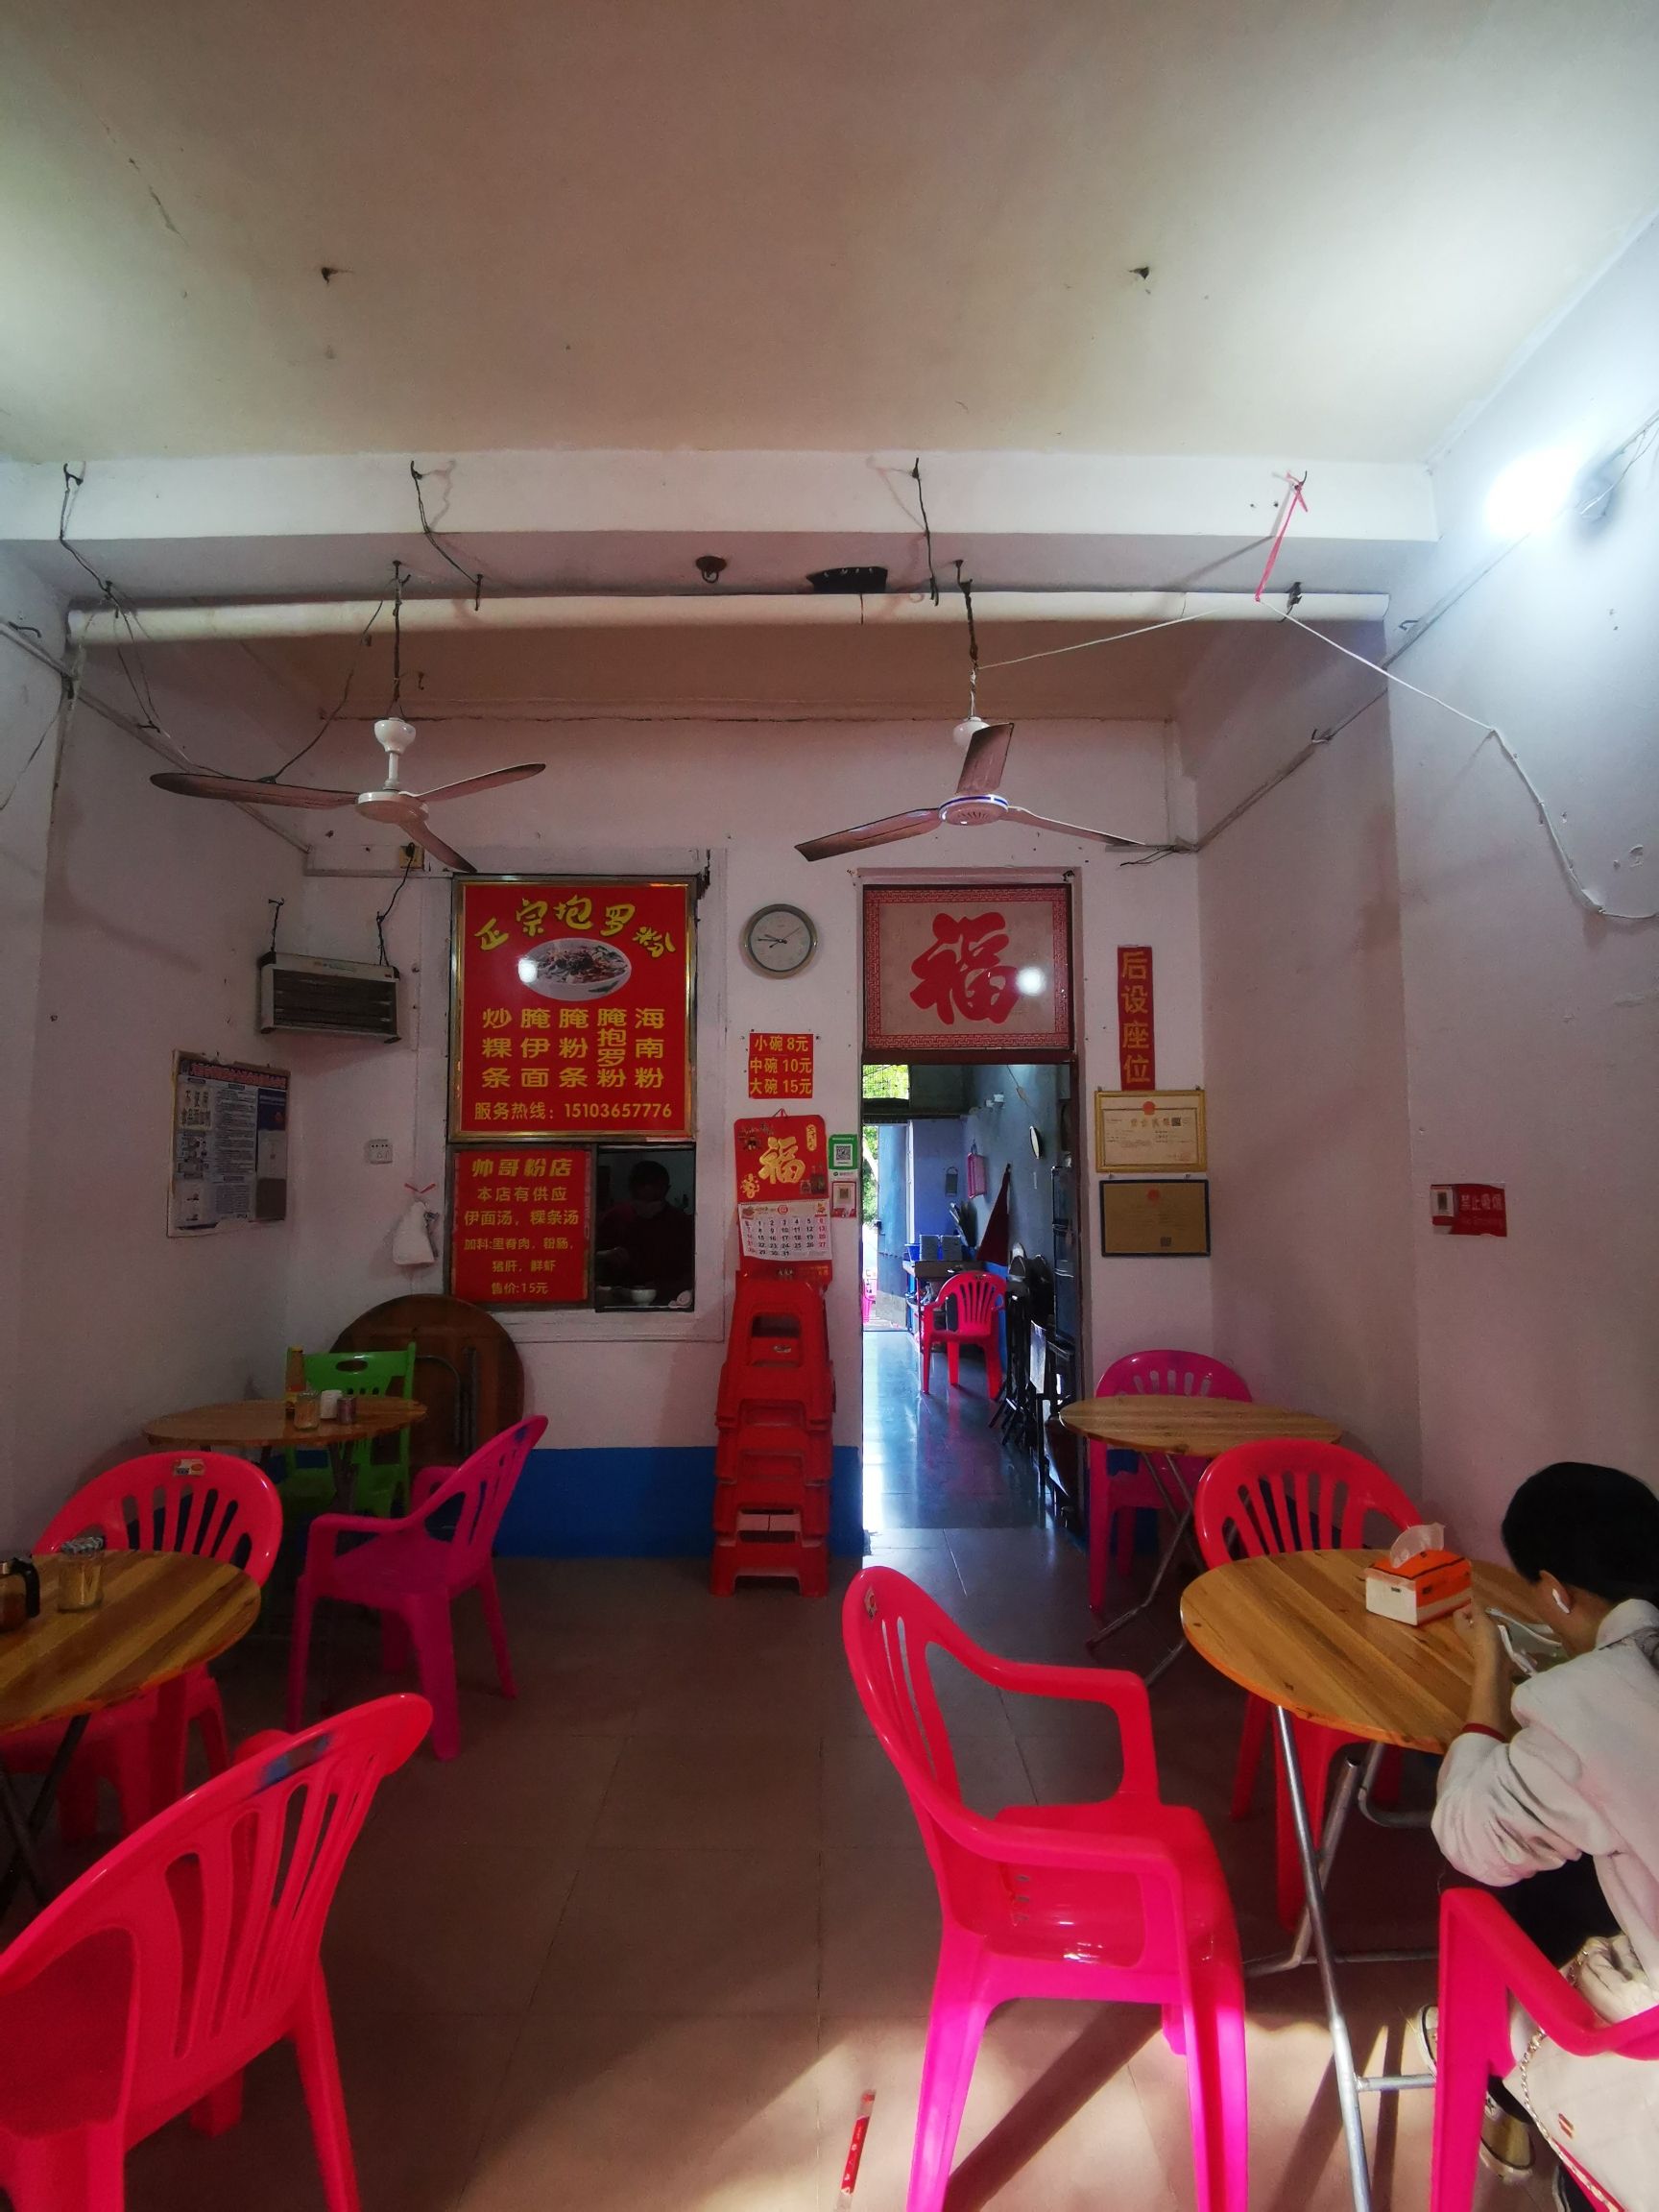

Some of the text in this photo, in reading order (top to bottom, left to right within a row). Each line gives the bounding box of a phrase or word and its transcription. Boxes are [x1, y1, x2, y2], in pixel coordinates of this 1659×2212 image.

[474, 895, 676, 958] 正宗抱罗粉
[909, 911, 1022, 1025] 福
[482, 1007, 513, 1089] 炒粿条
[520, 1007, 551, 1089] 腌伊面
[559, 1007, 589, 1089] 腌粉条
[597, 1007, 627, 1089] 腌抱罗粉
[635, 1007, 665, 1089] 海南粉
[755, 1035, 808, 1052] 小碗 8元
[1121, 950, 1151, 1084] 后设座位
[750, 1057, 812, 1074] 中碗 10元
[750, 1077, 812, 1094] 大碗 15元
[471, 1158, 573, 1177] 帅哥粉店
[477, 1186, 568, 1202] 本店有供应
[757, 1136, 806, 1185] 福
